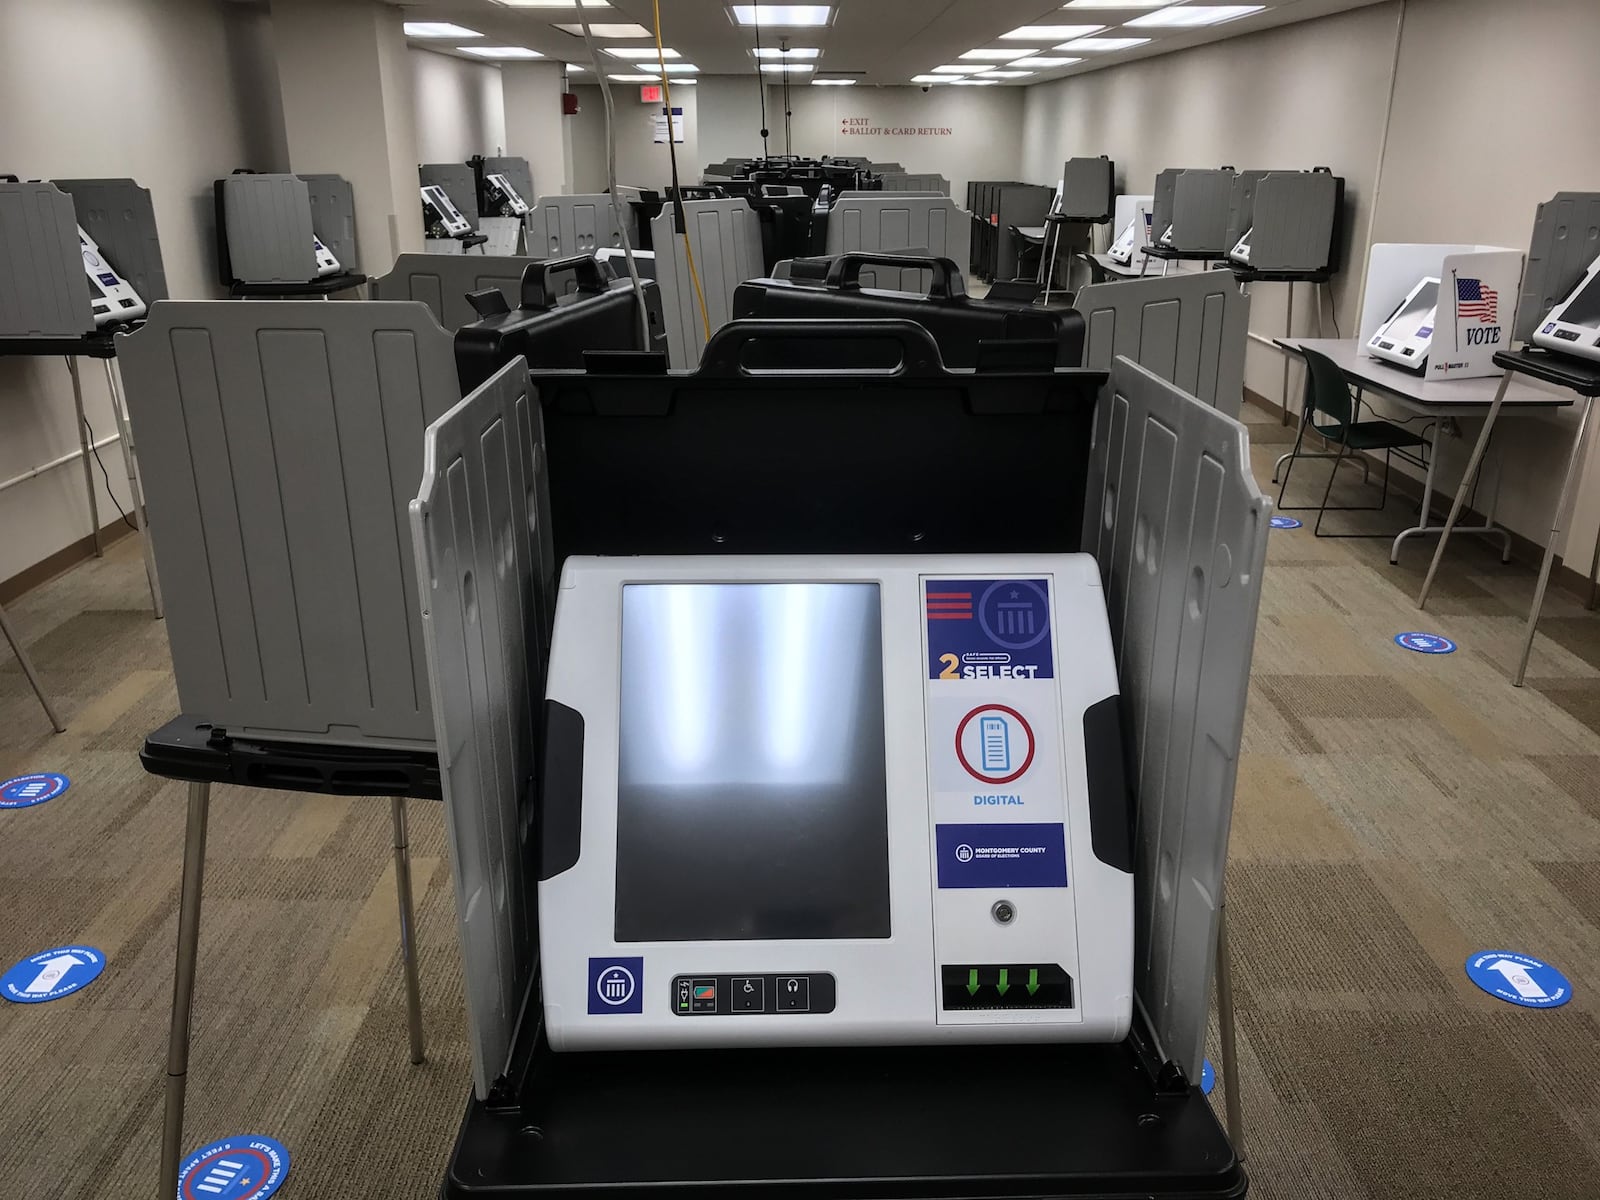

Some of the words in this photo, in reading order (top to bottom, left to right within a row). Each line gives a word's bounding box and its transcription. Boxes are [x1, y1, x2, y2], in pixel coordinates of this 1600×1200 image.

[849, 118, 869, 126] EXIT
[849, 127, 882, 136] BALLOT
[884, 127, 891, 136] &
[891, 127, 916, 136] CARD
[917, 127, 953, 136] RETURN
[1466, 326, 1501, 346] VOTE
[939, 653, 960, 680] 2
[963, 665, 1038, 680] SELECT
[974, 795, 1024, 806] DIGITAL
[201, 1145, 223, 1160] FEET
